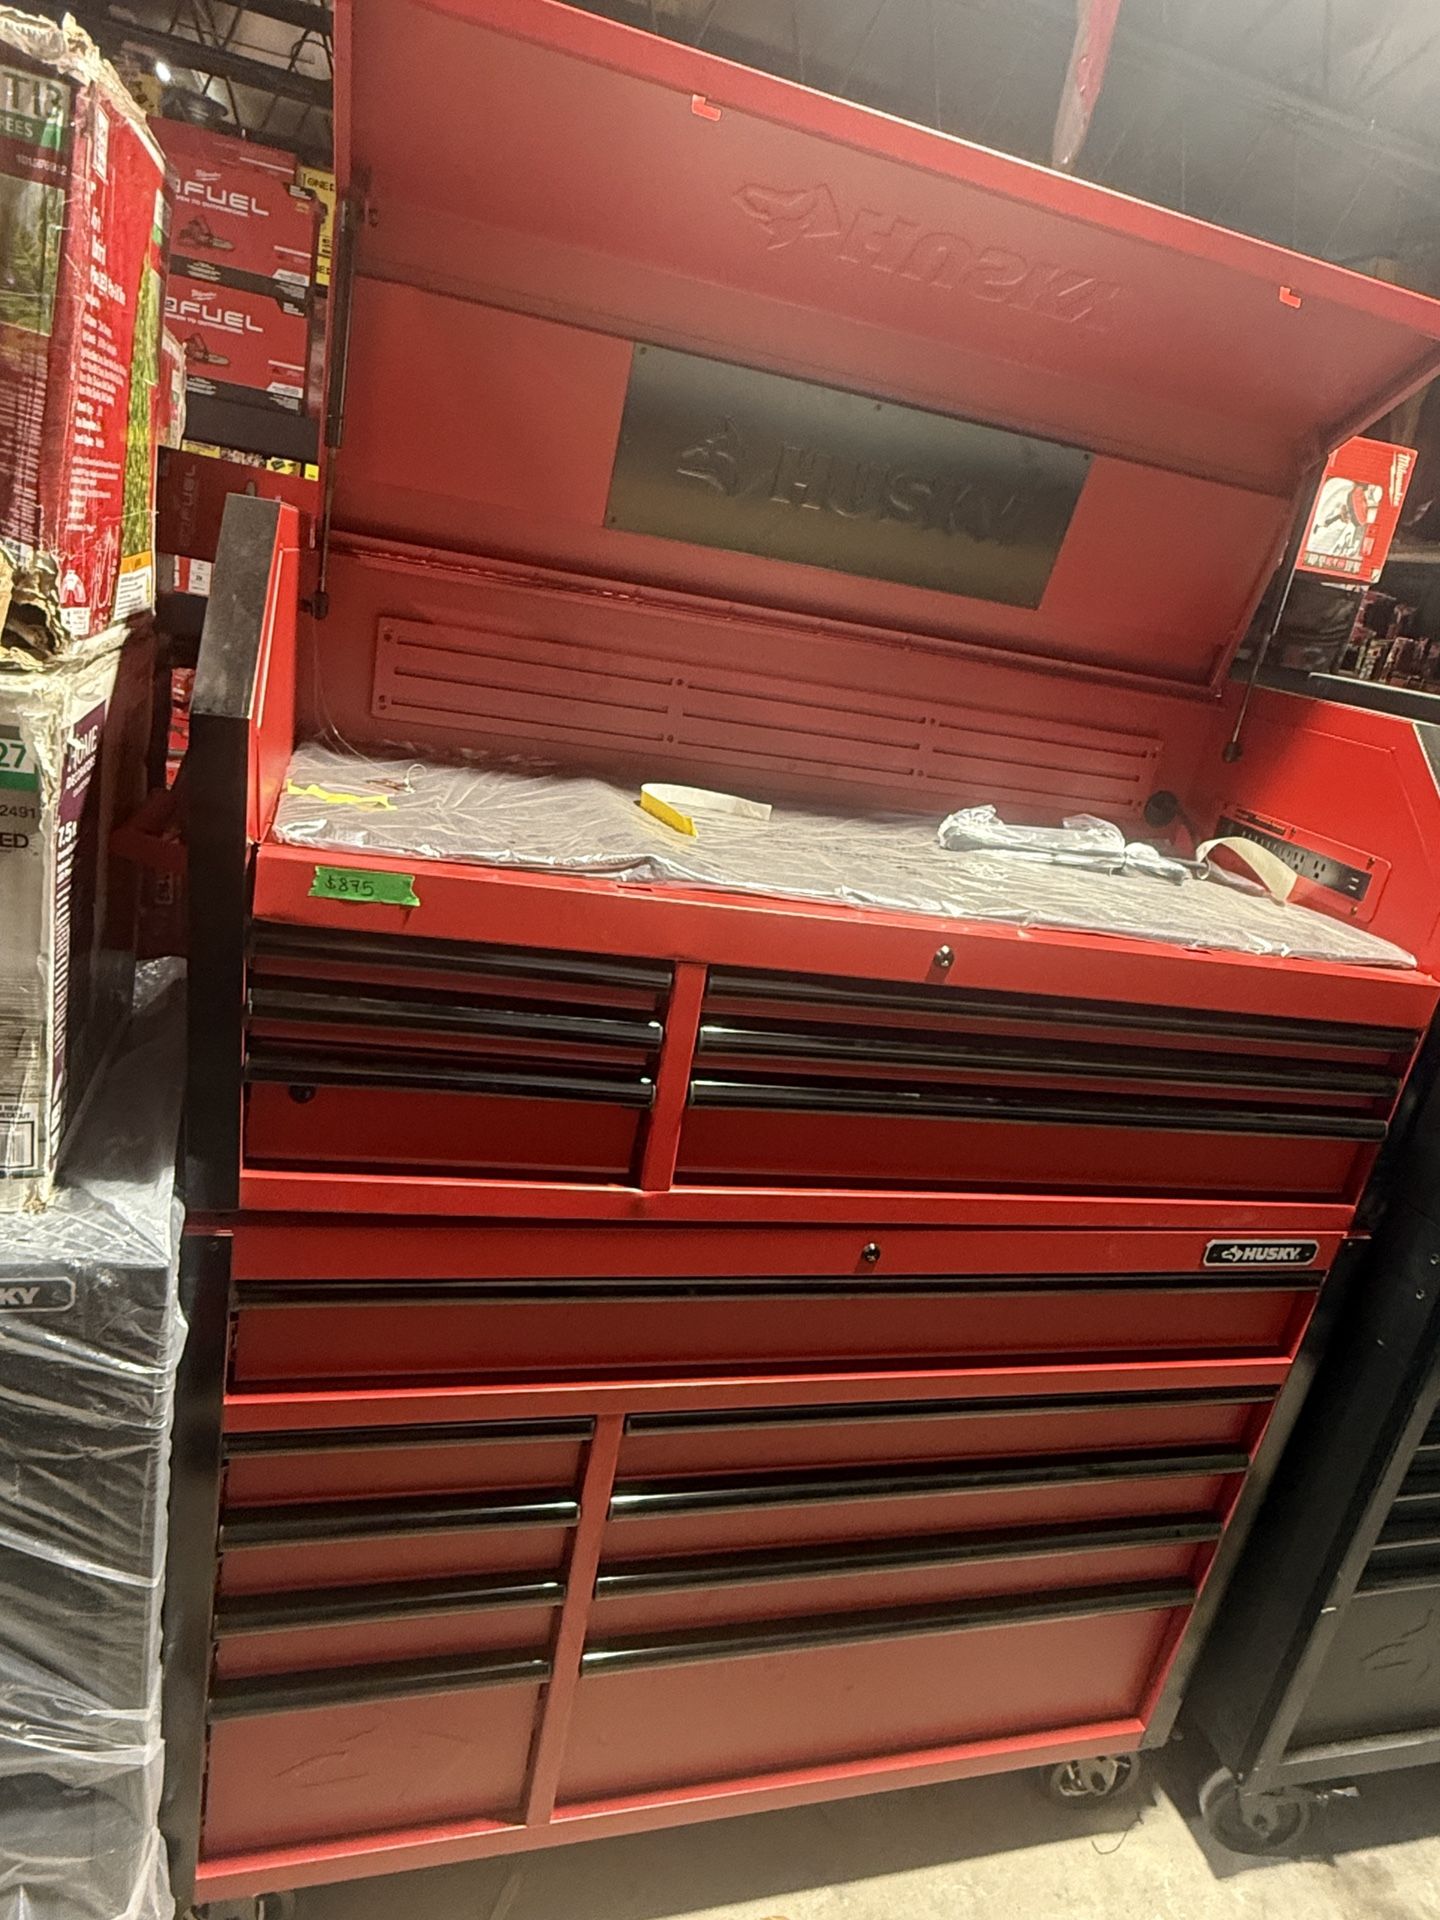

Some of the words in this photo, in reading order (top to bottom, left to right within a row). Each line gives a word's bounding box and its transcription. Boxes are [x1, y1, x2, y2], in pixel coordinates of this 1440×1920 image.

[184, 181, 269, 216] FUEL
[180, 300, 264, 333] FUEL
[324, 875, 374, 897] $875
[1241, 1247, 1301, 1260] HUSKY
